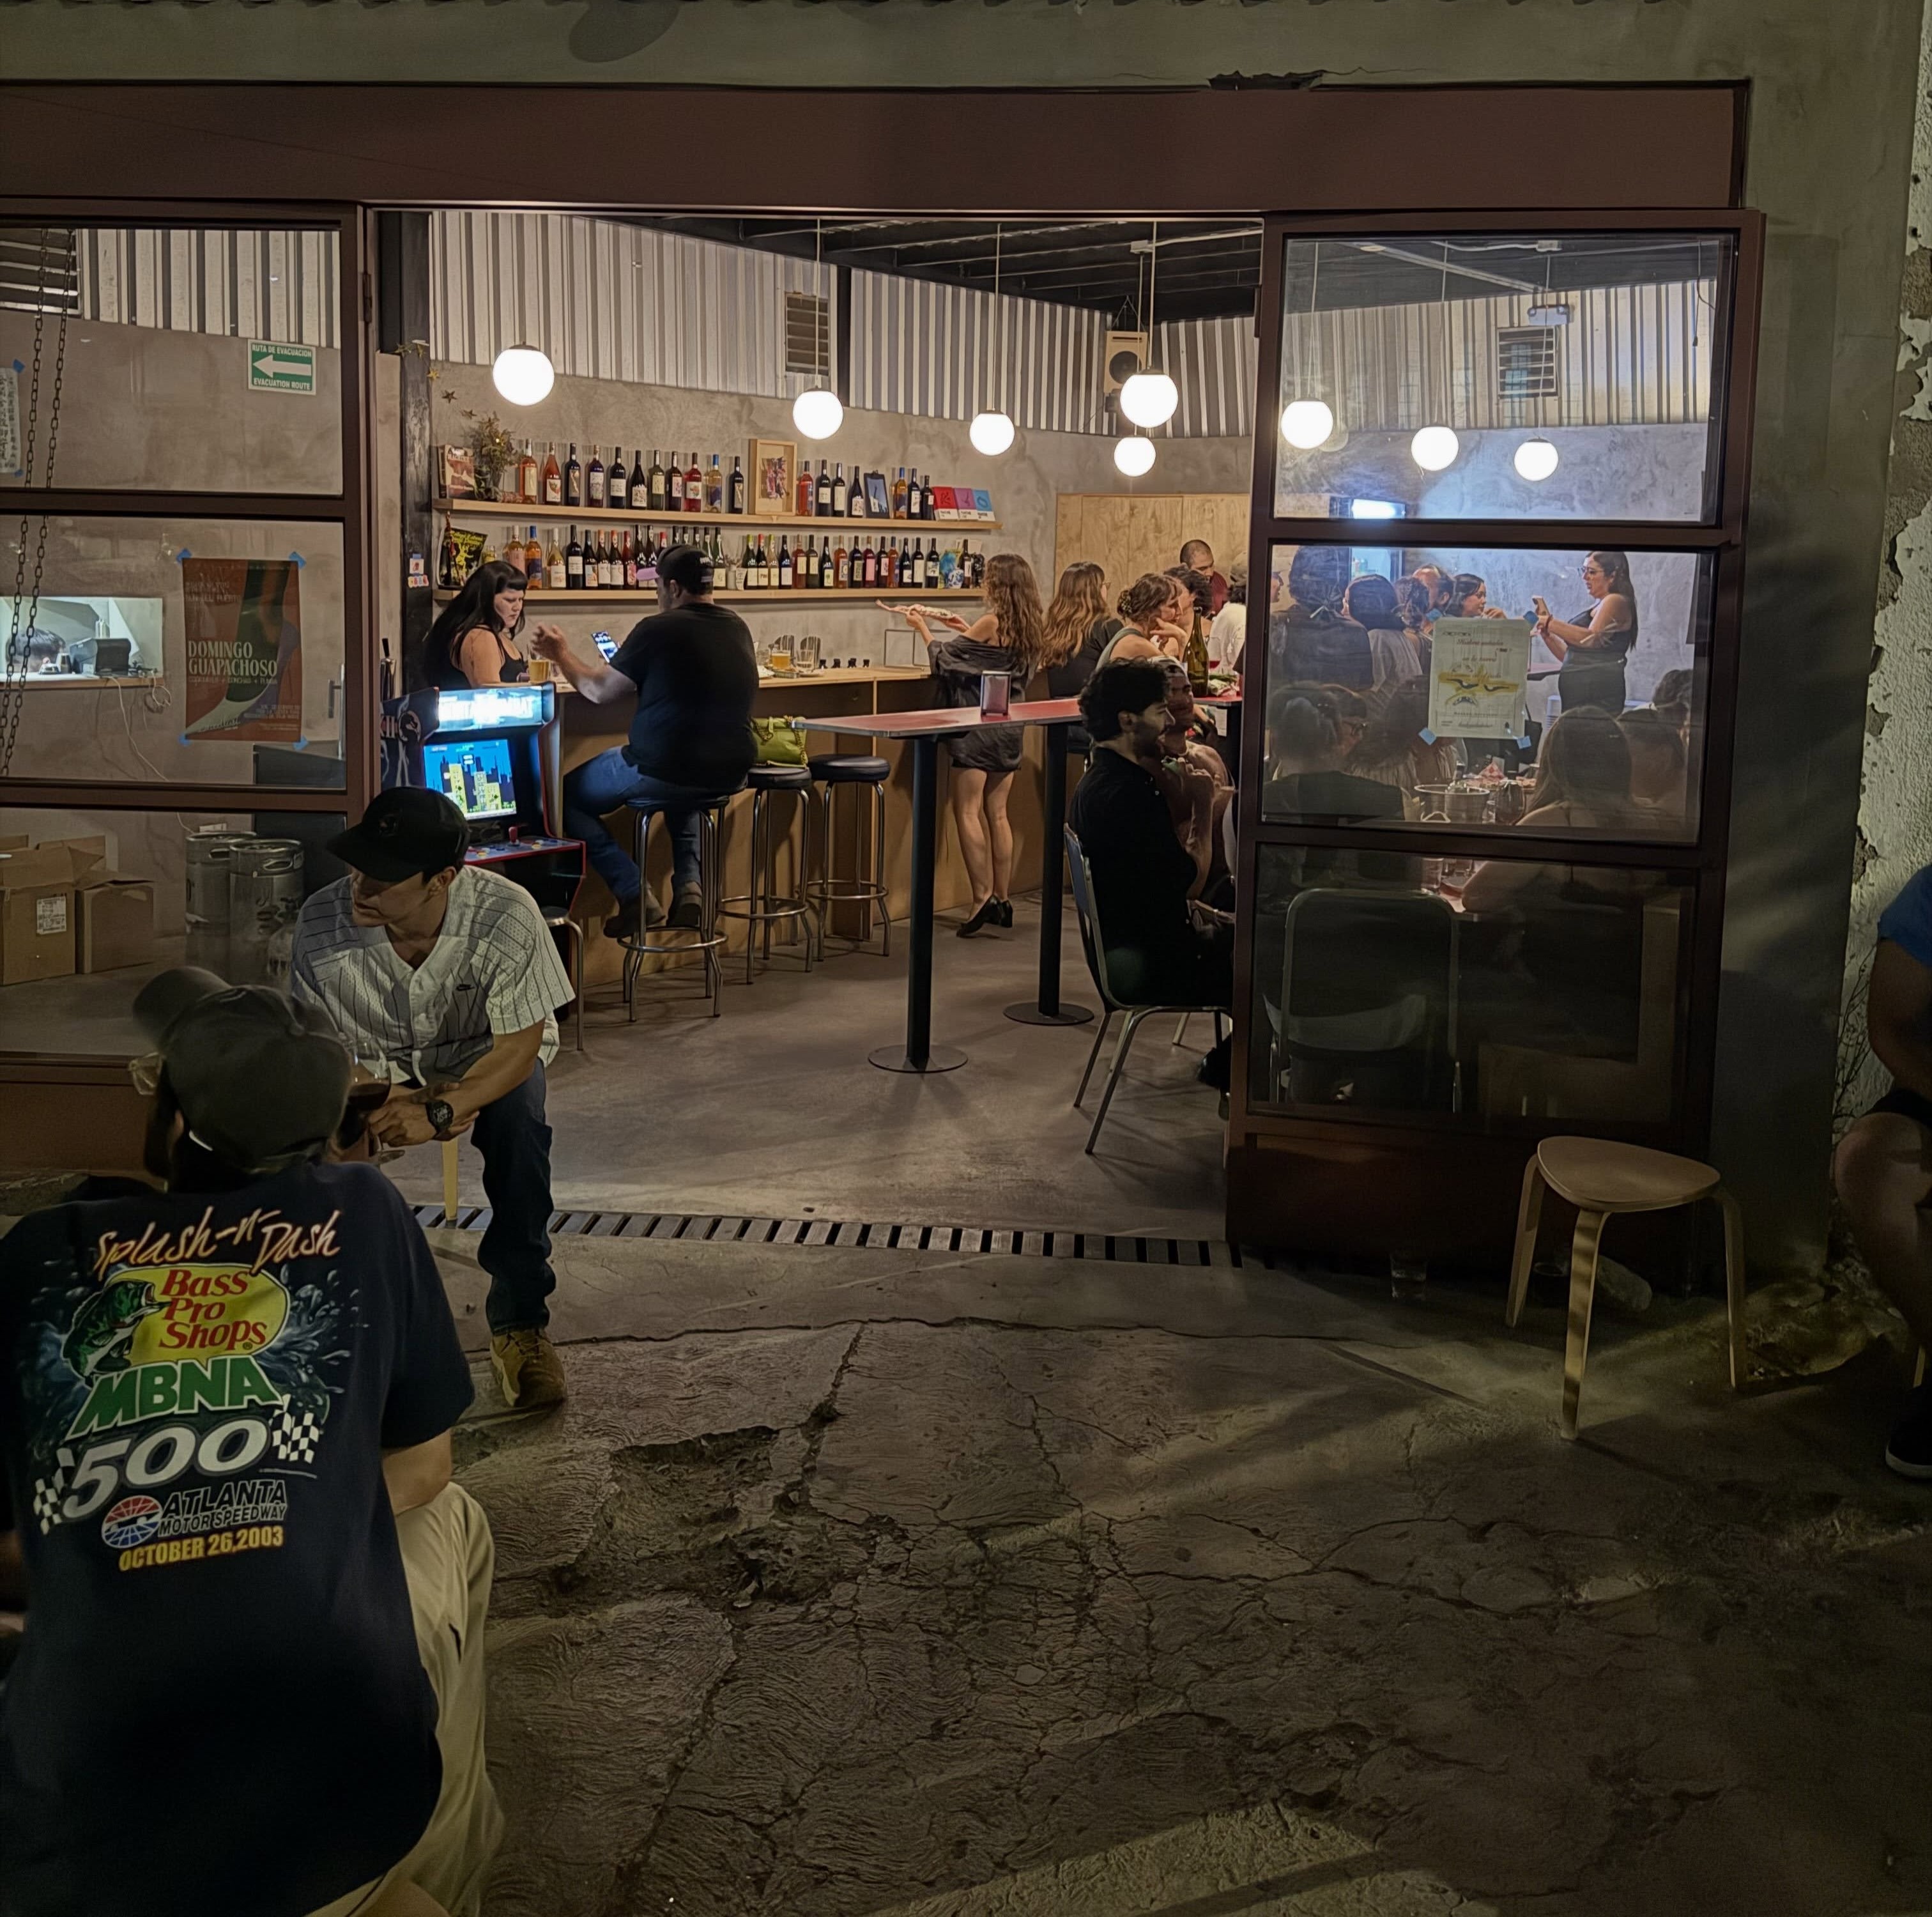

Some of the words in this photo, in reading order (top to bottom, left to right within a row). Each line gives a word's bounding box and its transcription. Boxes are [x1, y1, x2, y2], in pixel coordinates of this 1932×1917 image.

[252, 344, 267, 352] RUTA
[254, 378, 290, 388] EVACUATION
[188, 640, 253, 659] DOMINGO
[188, 658, 277, 677] GUAPACHOSO
[160, 1268, 249, 1298] Bass
[163, 1297, 226, 1323] Pro
[158, 1320, 267, 1351] Shops
[65, 1355, 284, 1440] MBNA
[63, 1418, 268, 1519] 500
[161, 1479, 287, 1520] ATLANTA
[158, 1513, 213, 1537] MOTOR
[214, 1505, 288, 1527] SPEEDWAY
[118, 1536, 205, 1571] OCTOBER
